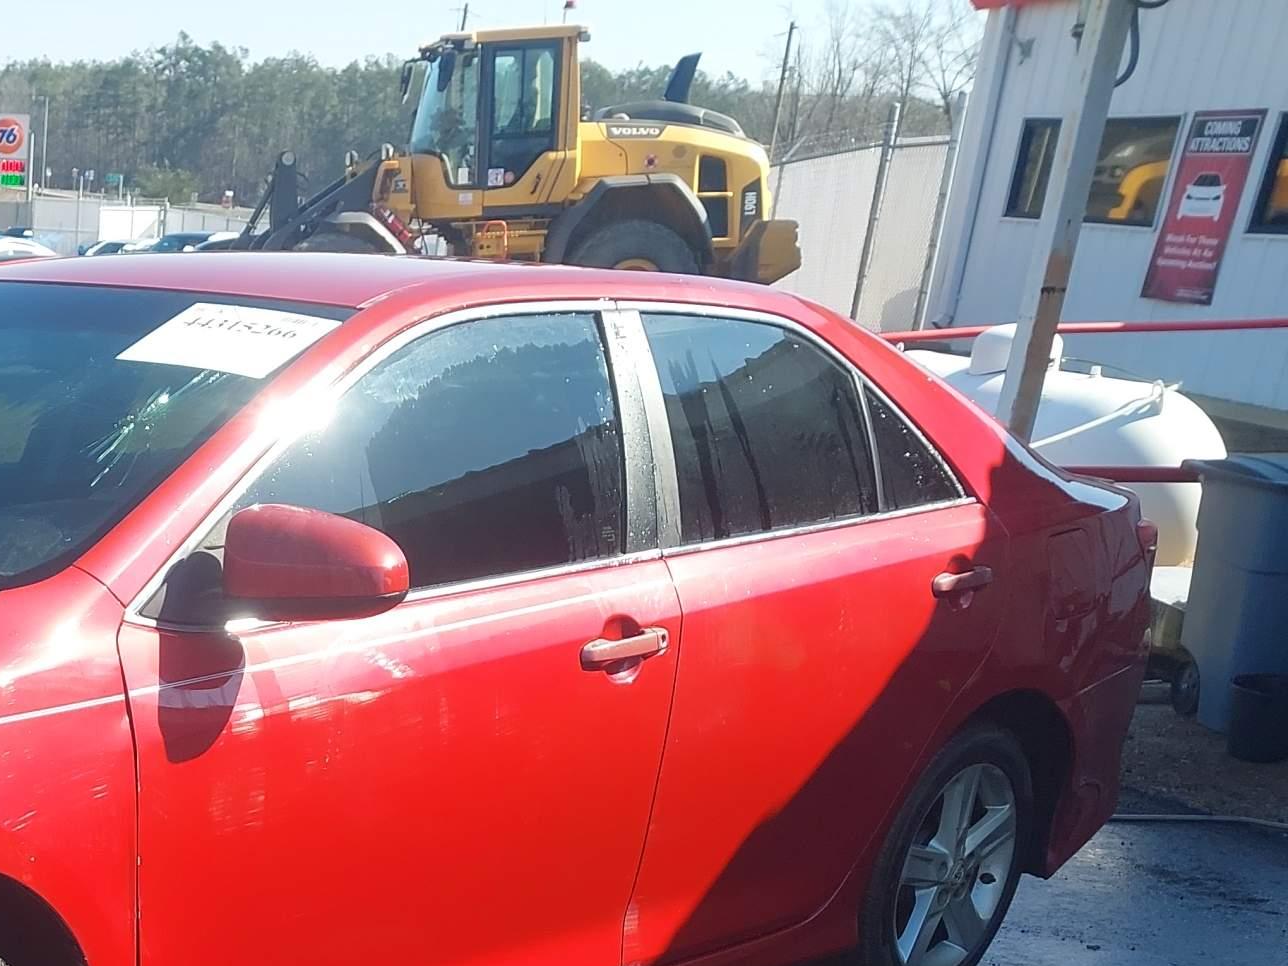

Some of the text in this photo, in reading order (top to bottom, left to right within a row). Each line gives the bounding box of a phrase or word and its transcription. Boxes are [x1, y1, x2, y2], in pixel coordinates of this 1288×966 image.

[610, 127, 661, 136] VOLVO
[1204, 120, 1242, 136] COMING
[1190, 136, 1251, 152] ATTRACTIONS
